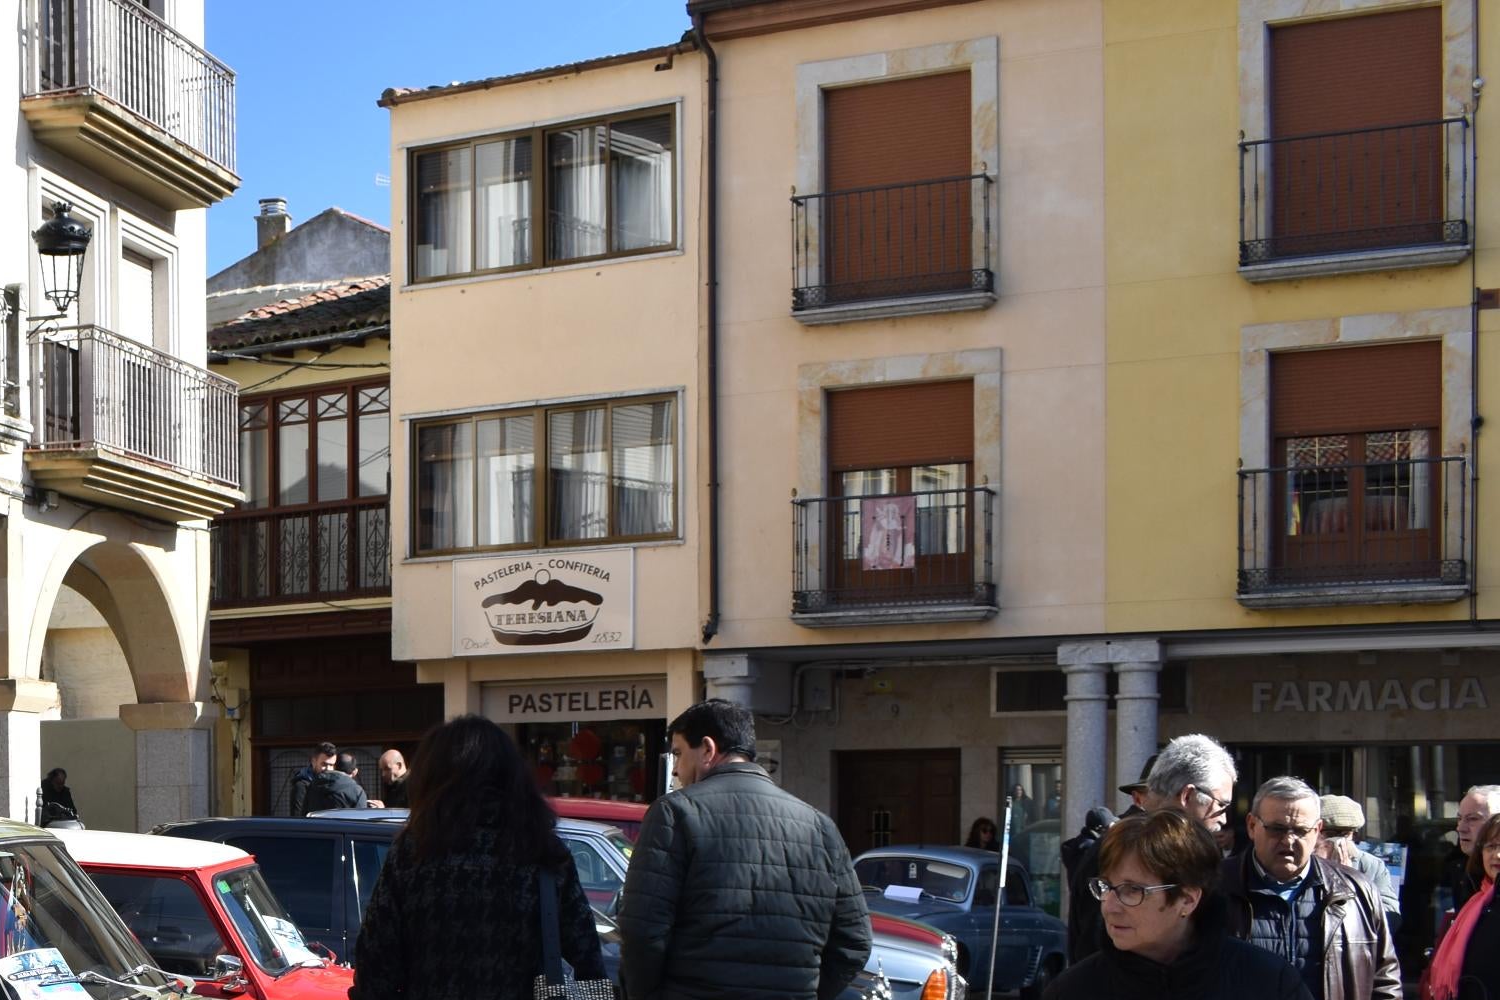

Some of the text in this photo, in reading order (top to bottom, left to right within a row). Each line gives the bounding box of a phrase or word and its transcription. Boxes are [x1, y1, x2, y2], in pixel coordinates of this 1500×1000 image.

[474, 561, 533, 590] PASTELERIA
[548, 558, 611, 582] CONFITERIA
[495, 610, 588, 626] TERESIANA
[591, 632, 622, 643] 1832
[508, 685, 654, 714] PASTELERÍA
[1252, 677, 1488, 713] FARMACIA
